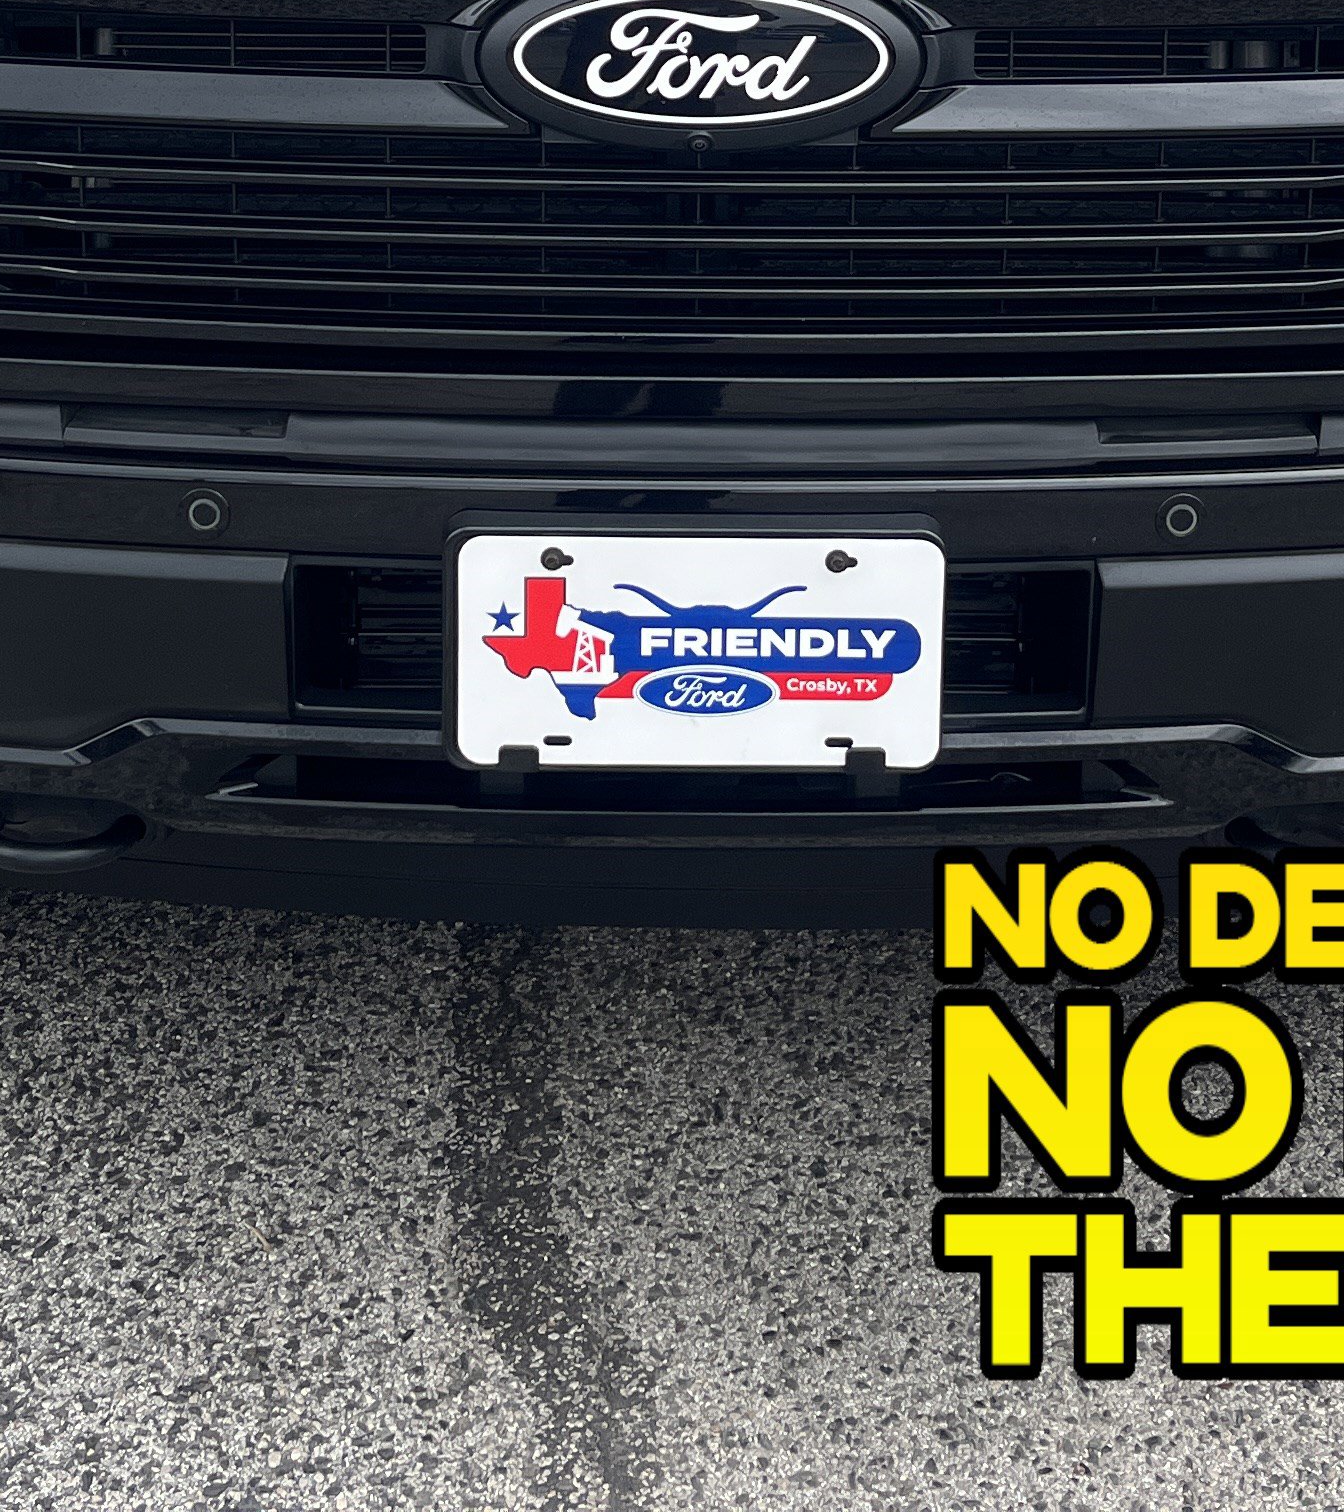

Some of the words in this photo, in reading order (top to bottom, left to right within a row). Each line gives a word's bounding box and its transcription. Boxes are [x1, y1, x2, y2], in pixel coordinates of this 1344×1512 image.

[586, 8, 817, 101] Ford
[640, 627, 897, 659] FRIENDLY
[664, 674, 749, 708] Ford
[786, 678, 851, 695] Crosby,
[854, 679, 878, 693] TX
